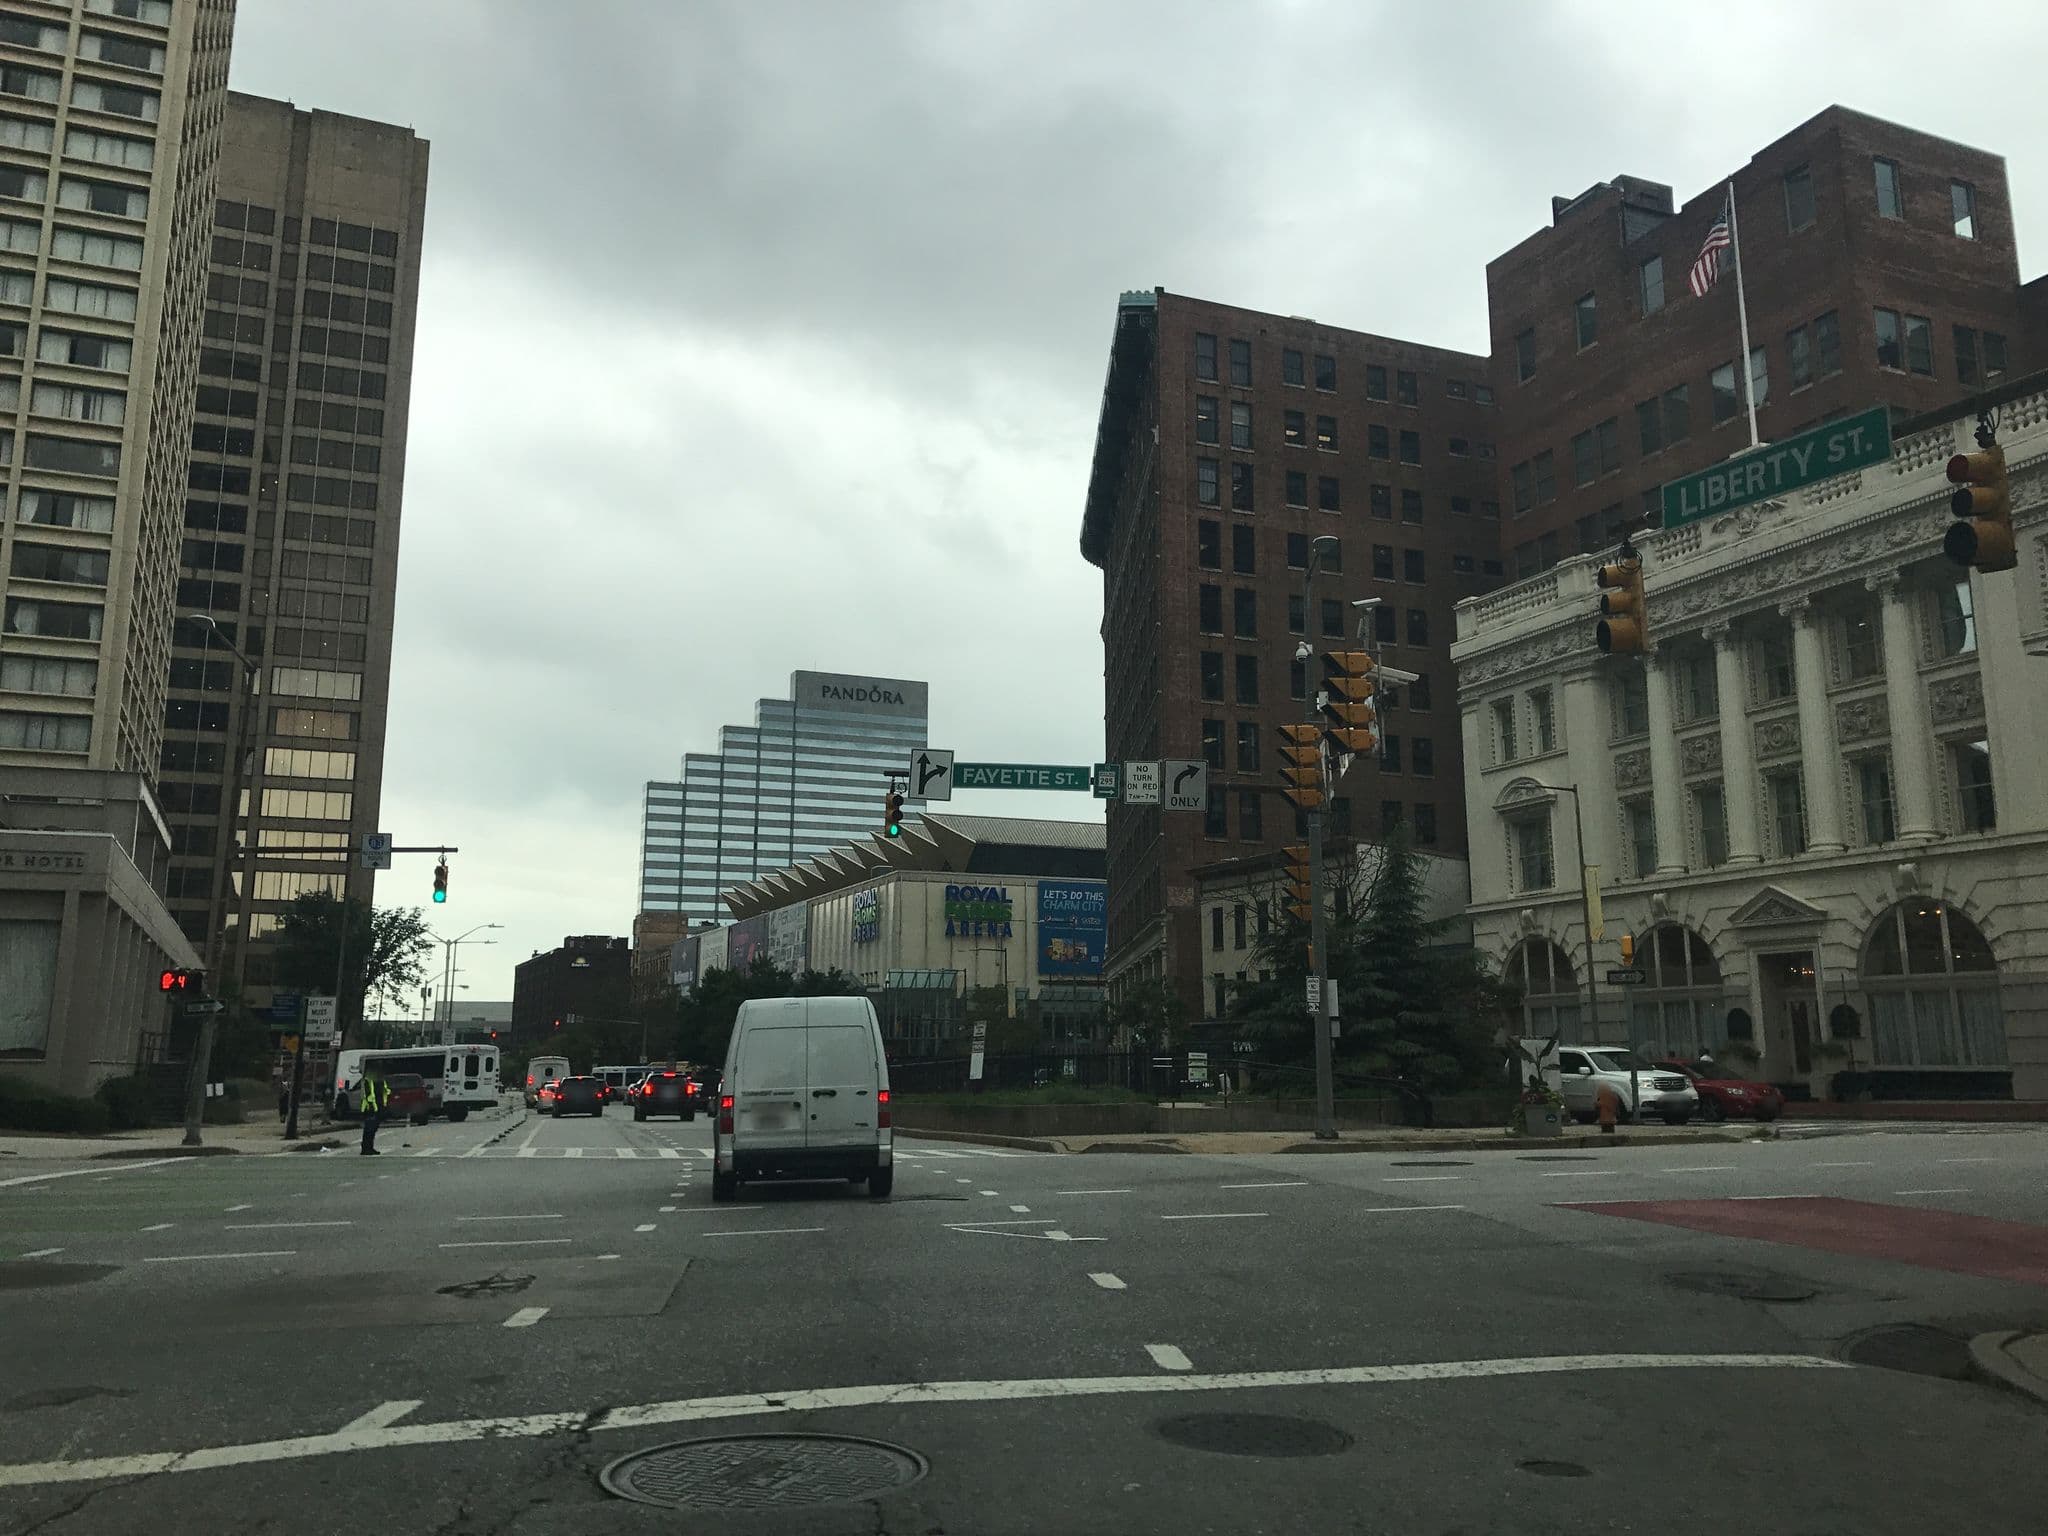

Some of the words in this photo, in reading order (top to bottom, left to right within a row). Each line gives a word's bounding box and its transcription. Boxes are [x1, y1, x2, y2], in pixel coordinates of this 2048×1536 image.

[1680, 442, 1815, 517] LIBERTY
[1827, 426, 1873, 463] ST.
[822, 685, 904, 704] PANDORA
[1136, 765, 1148, 773] NO
[963, 768, 1050, 785] FAYETTE
[1054, 772, 1079, 785] ST.
[1100, 777, 1113, 785] 295
[1171, 797, 1200, 807] ONLY
[24, 855, 84, 867] HOTEL
[853, 888, 877, 910] ROYAL
[945, 885, 1013, 903] ROYAL
[1044, 889, 1068, 900] LET'S
[1070, 891, 1083, 900] DO
[1043, 900, 1080, 911] CHARM
[1082, 901, 1105, 912] CITY
[946, 918, 1013, 938] ARENA
[178, 975, 186, 989] 4
